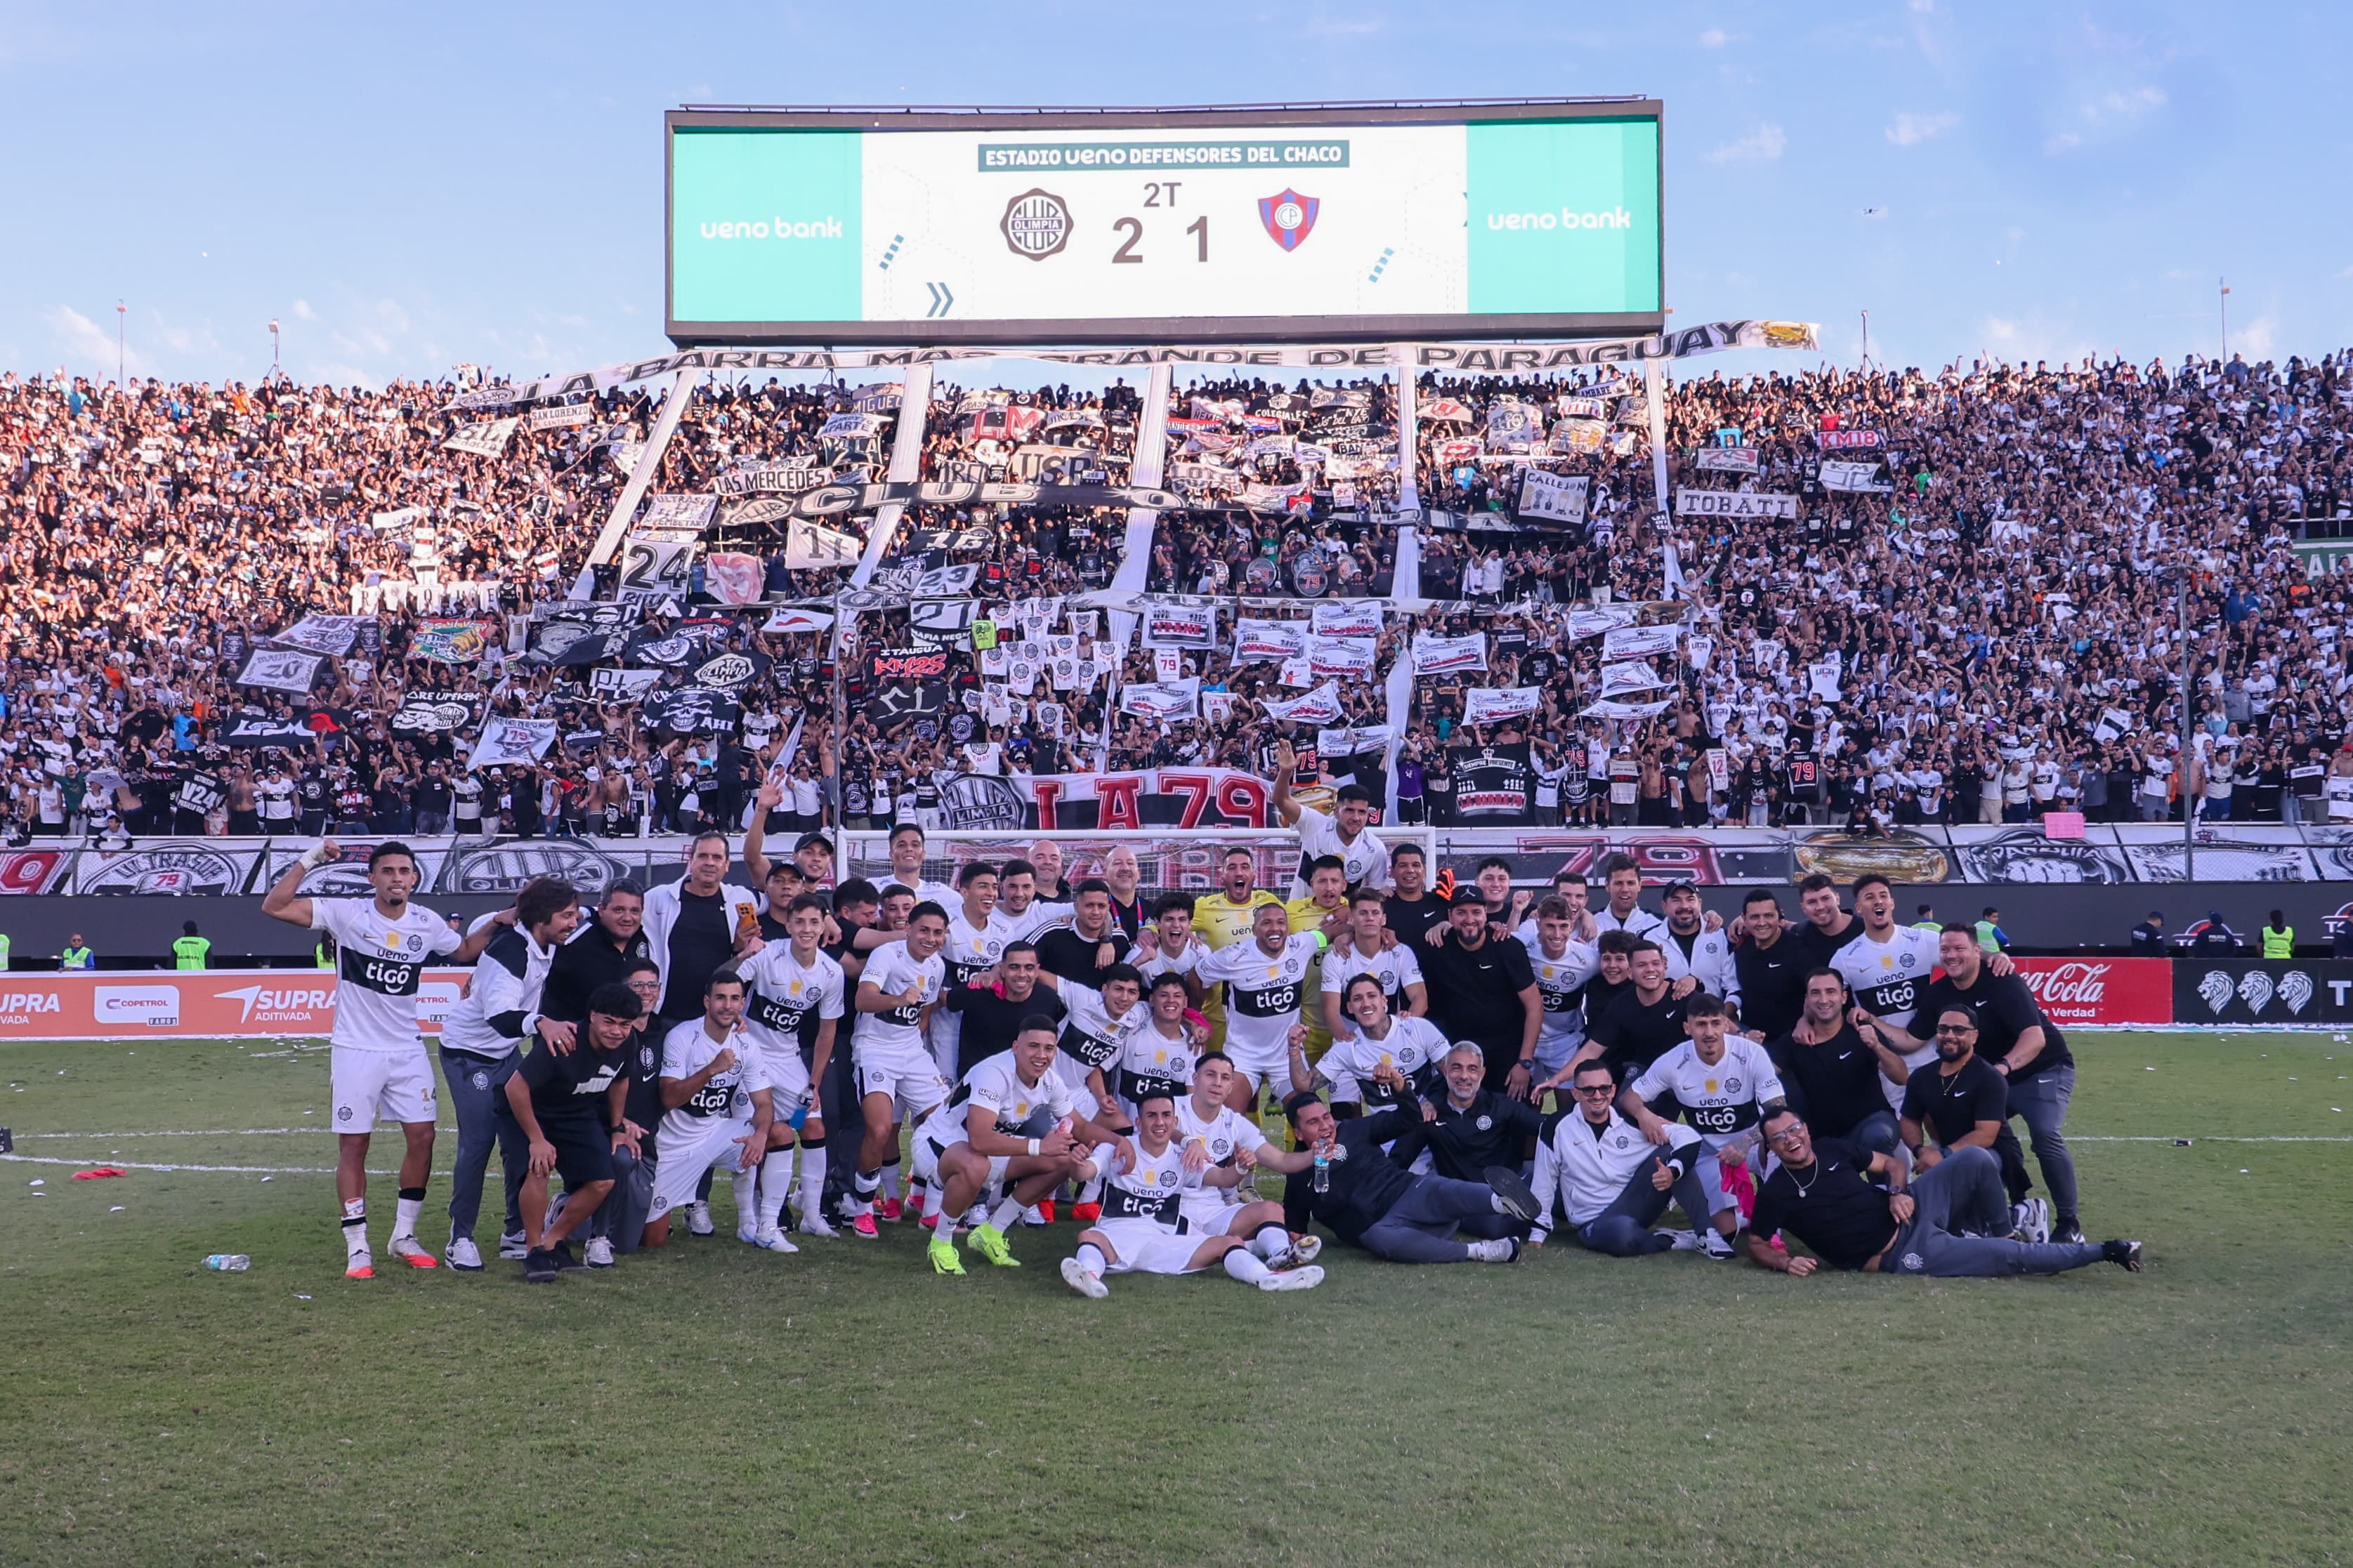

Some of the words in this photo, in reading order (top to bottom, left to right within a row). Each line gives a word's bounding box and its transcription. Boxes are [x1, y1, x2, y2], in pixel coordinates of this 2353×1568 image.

[985, 150, 1061, 166] ESTADIO
[1065, 149, 1127, 165] ueno
[1129, 147, 1242, 164] DEFENSORES
[1247, 146, 1280, 163] DEL
[1284, 146, 1342, 162] CHACO
[1143, 183, 1182, 208] 2T
[1014, 220, 1059, 230] OLIMPIA
[1487, 213, 1557, 230] ueno
[1562, 206, 1632, 229] bank
[700, 222, 770, 239] ueno
[775, 216, 843, 239] bank
[1112, 216, 1143, 264] 2
[1187, 216, 1207, 263] 1
[523, 372, 597, 399] LA
[627, 350, 836, 383] BARRA
[1309, 348, 1388, 366] DE
[1415, 319, 1752, 373] PARAGUAY
[532, 411, 548, 421] SAN
[550, 405, 589, 419] LORENZO
[853, 395, 903, 414] MIGUEL
[1255, 409, 1309, 422] COLEGIALES
[1818, 430, 1878, 450] KM18
[716, 475, 742, 494] LAS
[745, 469, 825, 492] MERCEDES
[799, 485, 1042, 515] CLUB
[1684, 494, 1790, 518] TOBATI
[622, 544, 690, 591] 24
[1303, 574, 1320, 589] 79
[880, 645, 943, 657] ITAUGUA
[700, 666, 747, 679] OLIMPIA
[874, 653, 947, 677] KM28
[1160, 659, 1176, 671] 79
[1421, 689, 1434, 705] 12
[509, 729, 530, 742] 79
[1464, 760, 1488, 770] SIEMPRE
[1489, 760, 1515, 770] PRESENTE
[1565, 749, 1585, 767] 79
[1790, 762, 1815, 782] 79
[181, 781, 219, 805] V24
[1158, 773, 1269, 831] 79
[115, 852, 225, 881] ULTRASUR
[1518, 836, 1728, 885] 79
[155, 873, 181, 886] 79
[377, 948, 409, 962] ueno
[963, 955, 990, 966] ueno
[365, 961, 412, 989] tigo
[1261, 977, 1290, 988] ueno
[1876, 972, 1905, 984] ueno
[257, 989, 336, 1010] SUPRA
[415, 996, 450, 1004] PETROL
[1256, 988, 1295, 1011] tigo
[1875, 980, 1915, 1006] tigo
[0, 993, 60, 1013] UPRA
[121, 999, 169, 1008] COPETROL
[777, 996, 804, 1009] ueno
[254, 1012, 312, 1022] ADITIVADA
[762, 1003, 802, 1028] tigo
[2052, 1007, 2096, 1017] Verdad
[148, 1017, 178, 1026] VAMOS
[1094, 1031, 1116, 1044] ueno
[1080, 1039, 1115, 1066] tigo
[1143, 1067, 1170, 1079] ueno
[690, 1088, 727, 1112] tigo
[979, 1087, 1000, 1102] wepa
[1698, 1097, 1729, 1108] ueno
[1695, 1107, 1738, 1130] tigo
[1132, 1186, 1164, 1199] ueno
